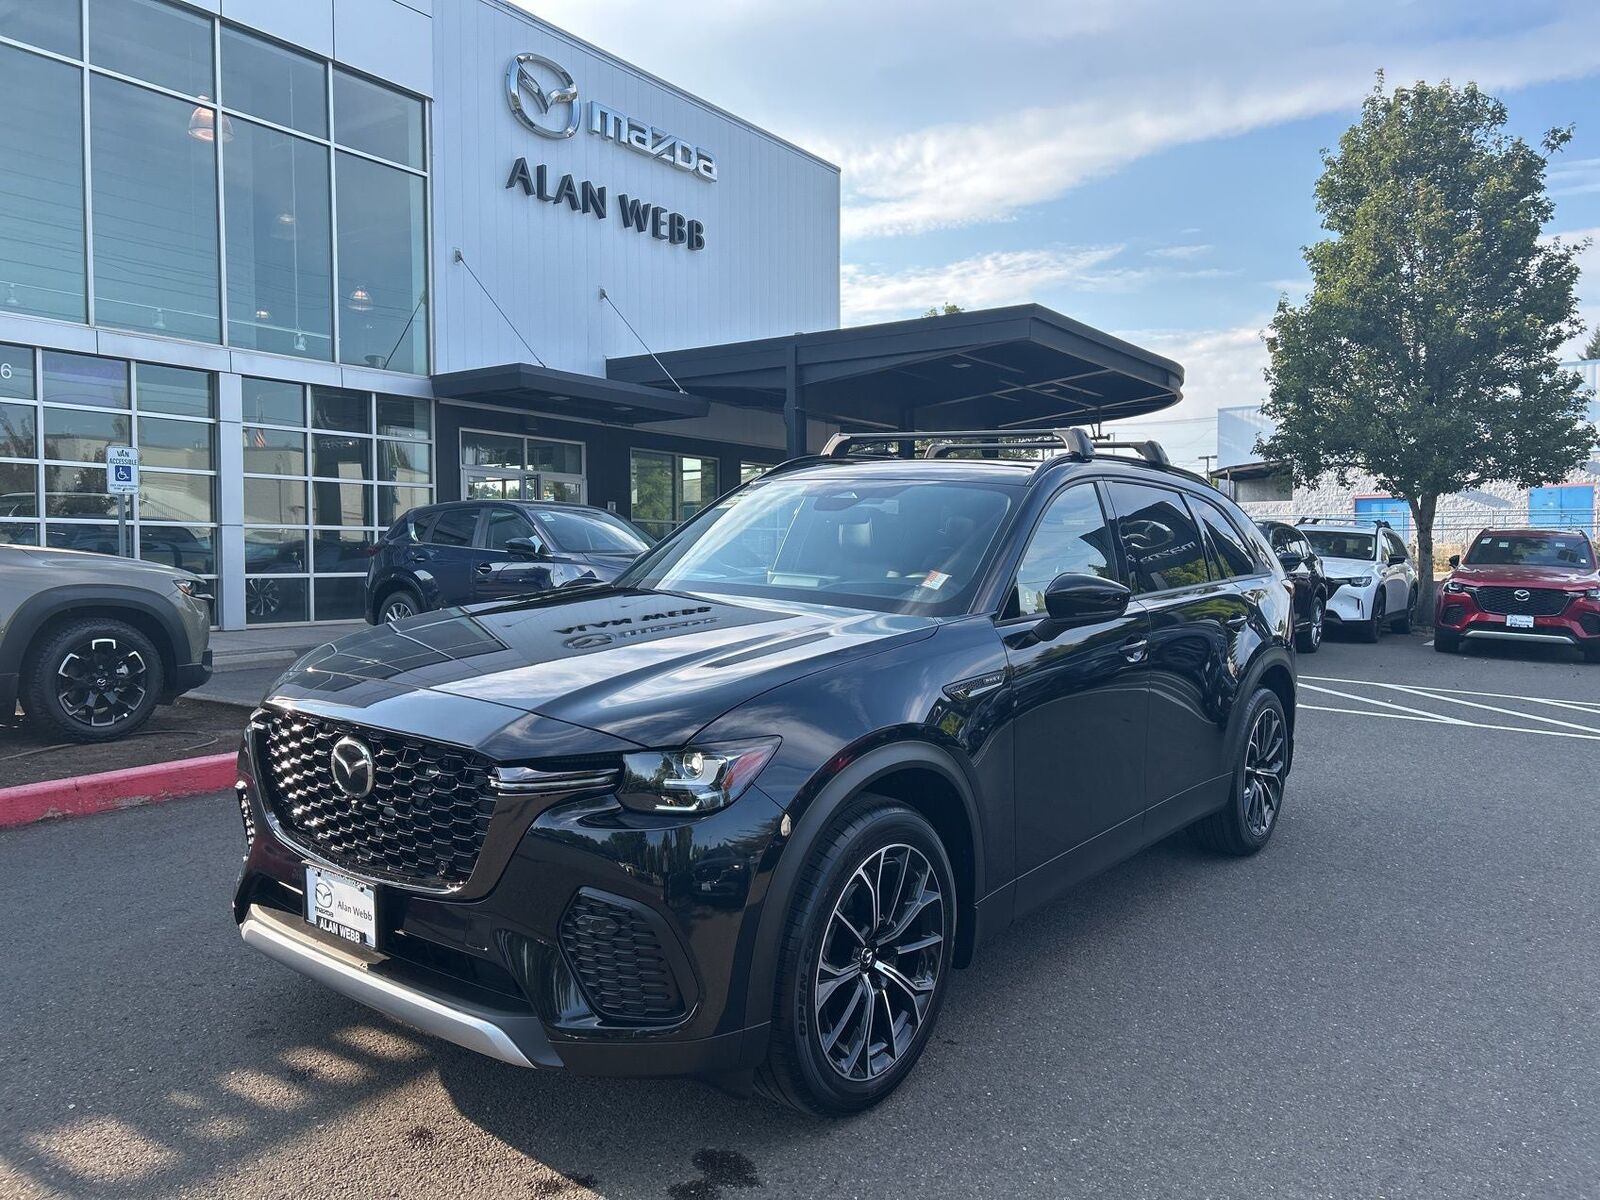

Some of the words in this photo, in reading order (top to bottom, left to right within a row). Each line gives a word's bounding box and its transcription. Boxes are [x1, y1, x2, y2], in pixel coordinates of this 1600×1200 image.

[505, 156, 607, 219] ALAN
[618, 193, 705, 251] WEBB
[109, 457, 137, 466] ACCESSIBLE
[116, 450, 130, 458] VAN
[337, 900, 352, 914] Alan
[353, 906, 373, 922] Webb
[320, 917, 339, 935] ALAN
[339, 923, 361, 944] WEBB
